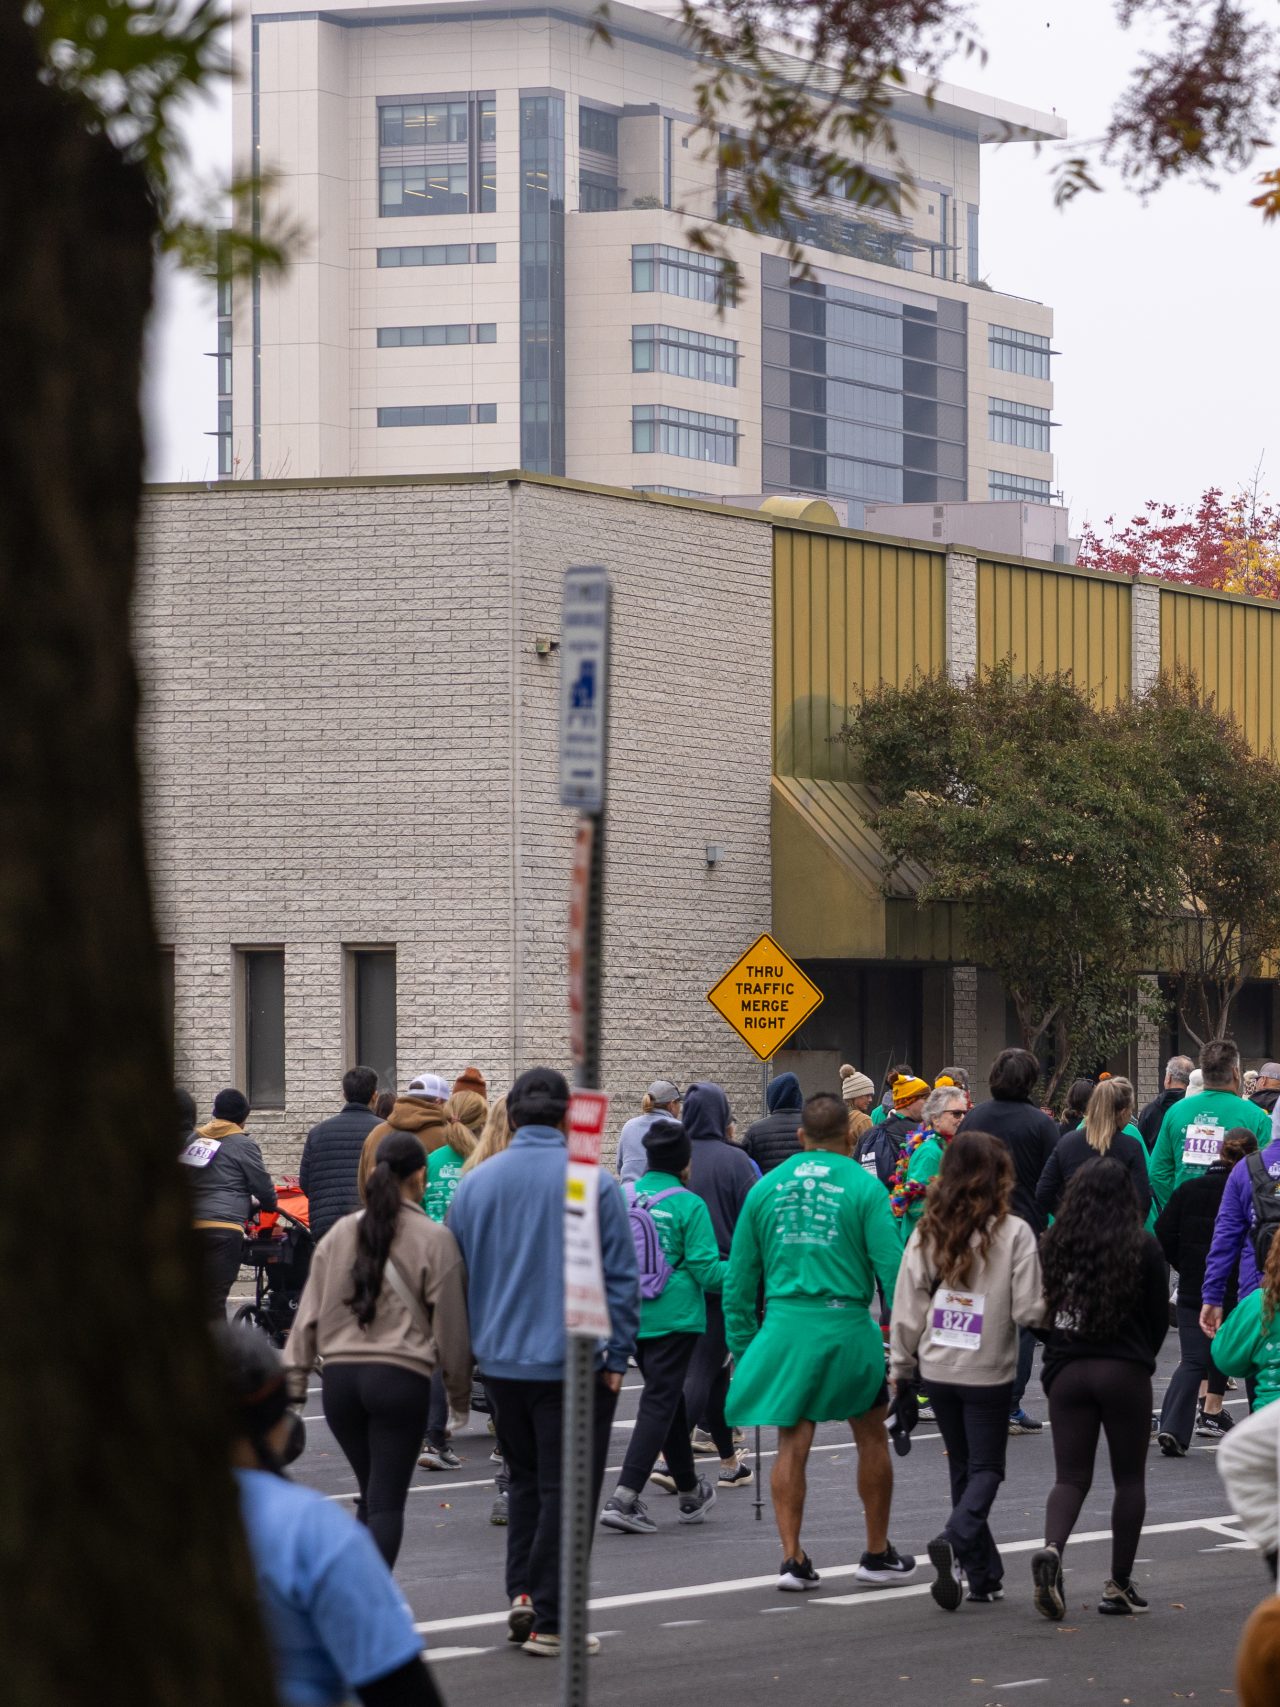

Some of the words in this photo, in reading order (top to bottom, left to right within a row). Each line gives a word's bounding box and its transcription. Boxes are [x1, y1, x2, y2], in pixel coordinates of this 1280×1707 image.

[746, 966, 784, 977] THRU
[736, 983, 794, 995] TRAFFIC
[741, 1000, 789, 1011] MERGE
[744, 1017, 786, 1029] RIGHT
[1187, 1138, 1218, 1154] 1148
[942, 1311, 974, 1331] 827
